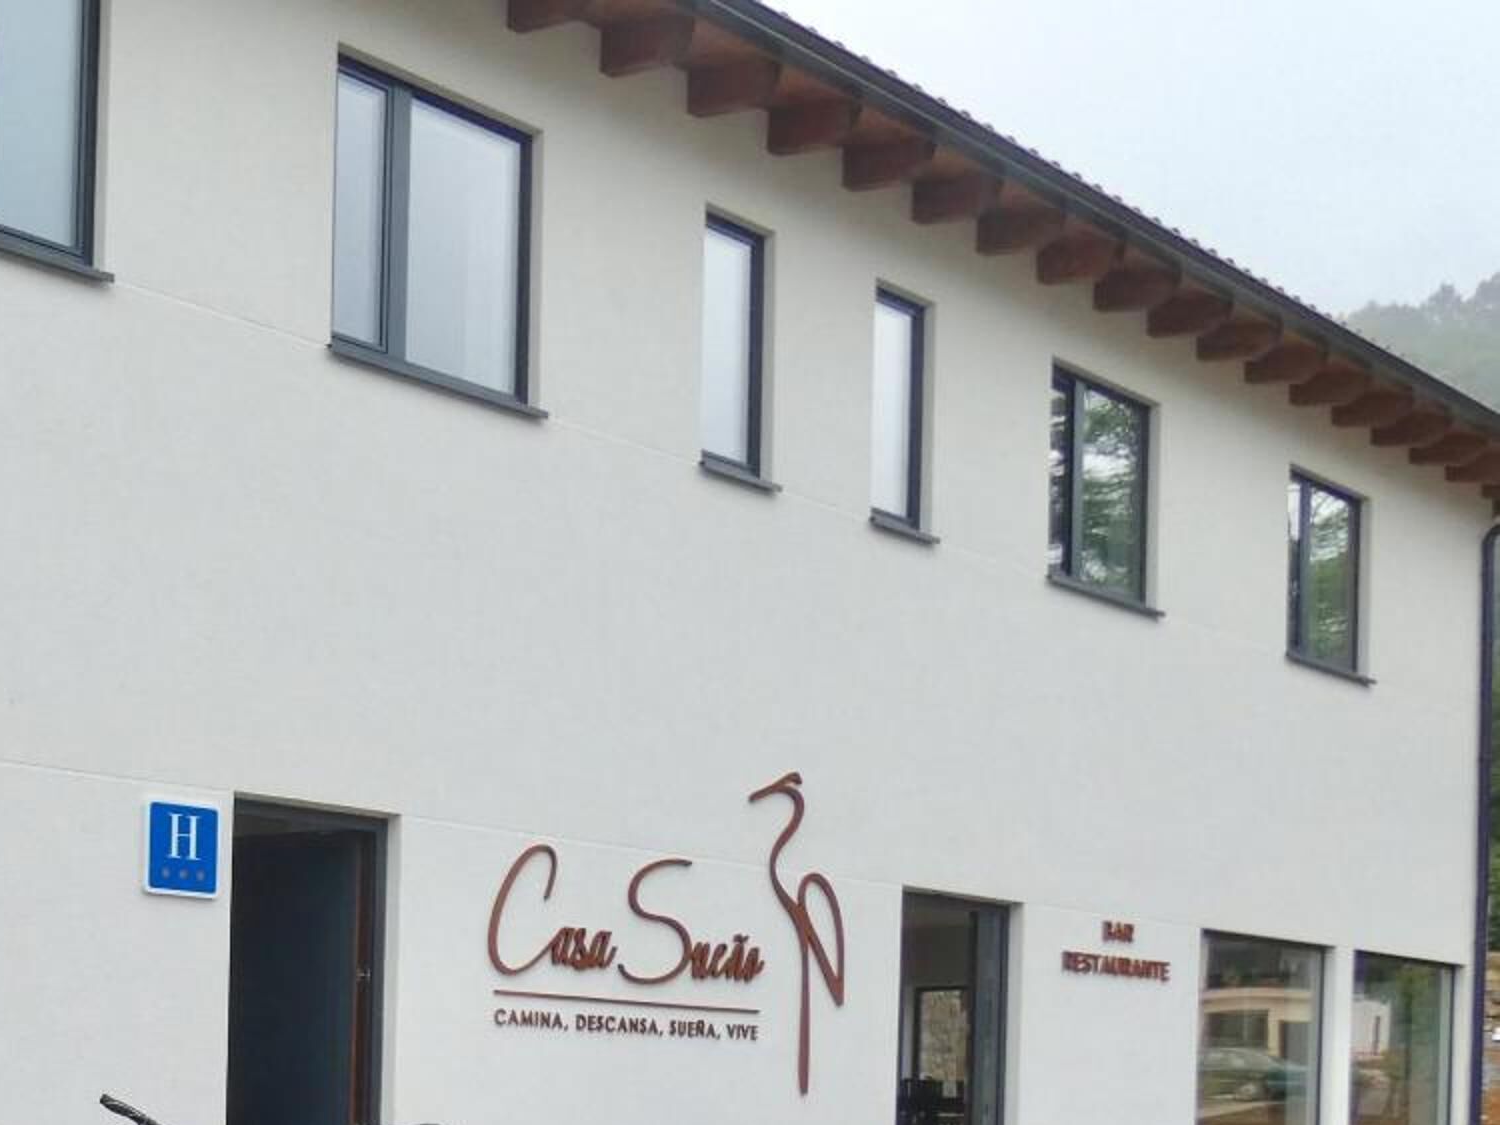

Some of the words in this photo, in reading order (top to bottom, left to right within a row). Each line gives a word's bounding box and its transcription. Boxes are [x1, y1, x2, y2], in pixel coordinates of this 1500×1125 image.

[167, 812, 201, 861] H
[487, 843, 618, 976] Casa
[1061, 951, 1171, 982] RESTAURANTE
[493, 1008, 569, 1031] CAMINA,
[575, 1013, 664, 1037] DESCANSA,
[726, 1023, 760, 1041] VIVE
